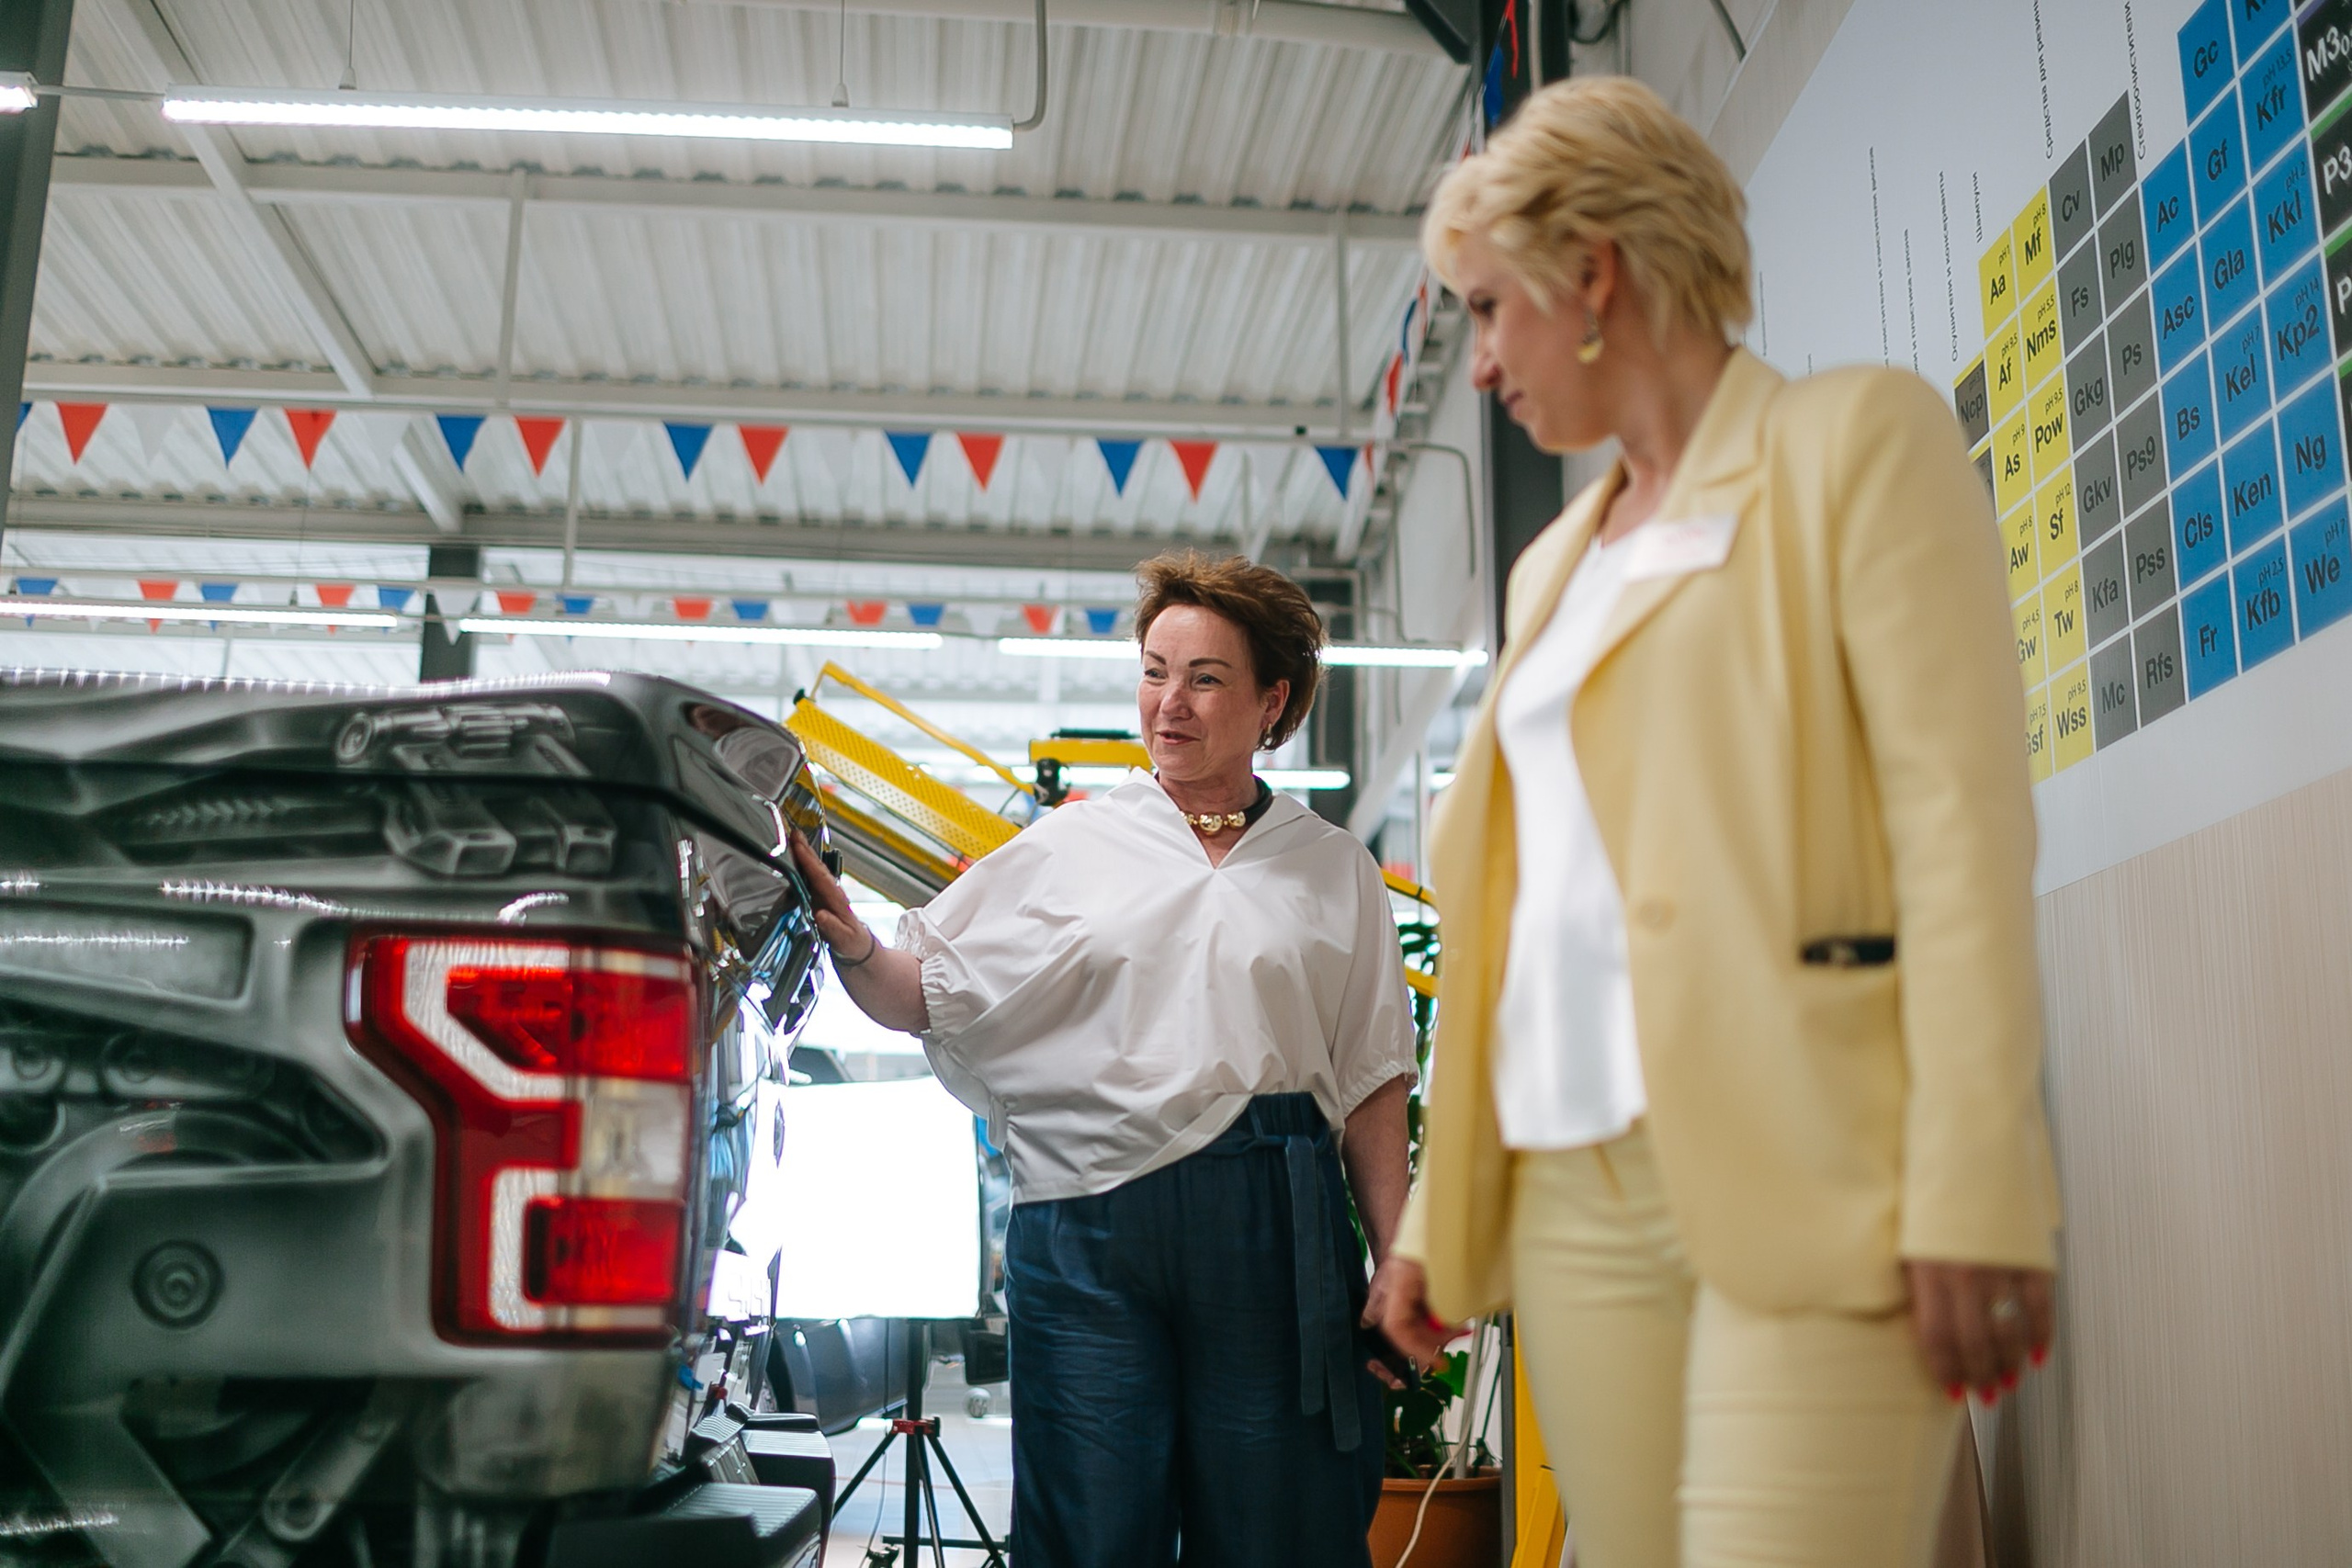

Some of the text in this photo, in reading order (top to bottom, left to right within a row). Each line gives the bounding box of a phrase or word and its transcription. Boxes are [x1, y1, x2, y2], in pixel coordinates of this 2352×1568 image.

[2038, 54, 2047, 82] для
[2194, 40, 2219, 78] Gc
[2124, 1, 2145, 160] Стеклоочистители
[2041, 85, 2053, 160] Средства
[2256, 85, 2287, 131] Kfr
[2100, 143, 2124, 182] Mp
[2207, 139, 2227, 180] Gf
[1973, 171, 1983, 243] Шампуни
[2025, 227, 2041, 265] Mf
[2109, 240, 2134, 279] Plg
[1990, 274, 2007, 306] Aa
[2071, 287, 2089, 317] Fs
[1948, 279, 1958, 362] Осушители
[2164, 296, 2194, 340] Asc
[2278, 304, 2320, 361] Kp2
[2026, 320, 2057, 362] Nms
[1998, 356, 2011, 391] Af
[2075, 378, 2104, 416] Gkg
[2177, 406, 2200, 441] Bs
[2005, 453, 2020, 482] As
[2126, 435, 2155, 480] Ps9
[2295, 434, 2326, 474] Ng
[2233, 473, 2271, 516] Ken
[2050, 508, 2064, 540] Sf
[2135, 547, 2165, 584] Pss
[2304, 554, 2340, 594] We
[2092, 578, 2119, 613] Kfa
[2246, 587, 2280, 631] Kfb
[2199, 623, 2217, 658] Fr
[2145, 652, 2174, 689] Rfs
[2056, 706, 2086, 739] Wss
